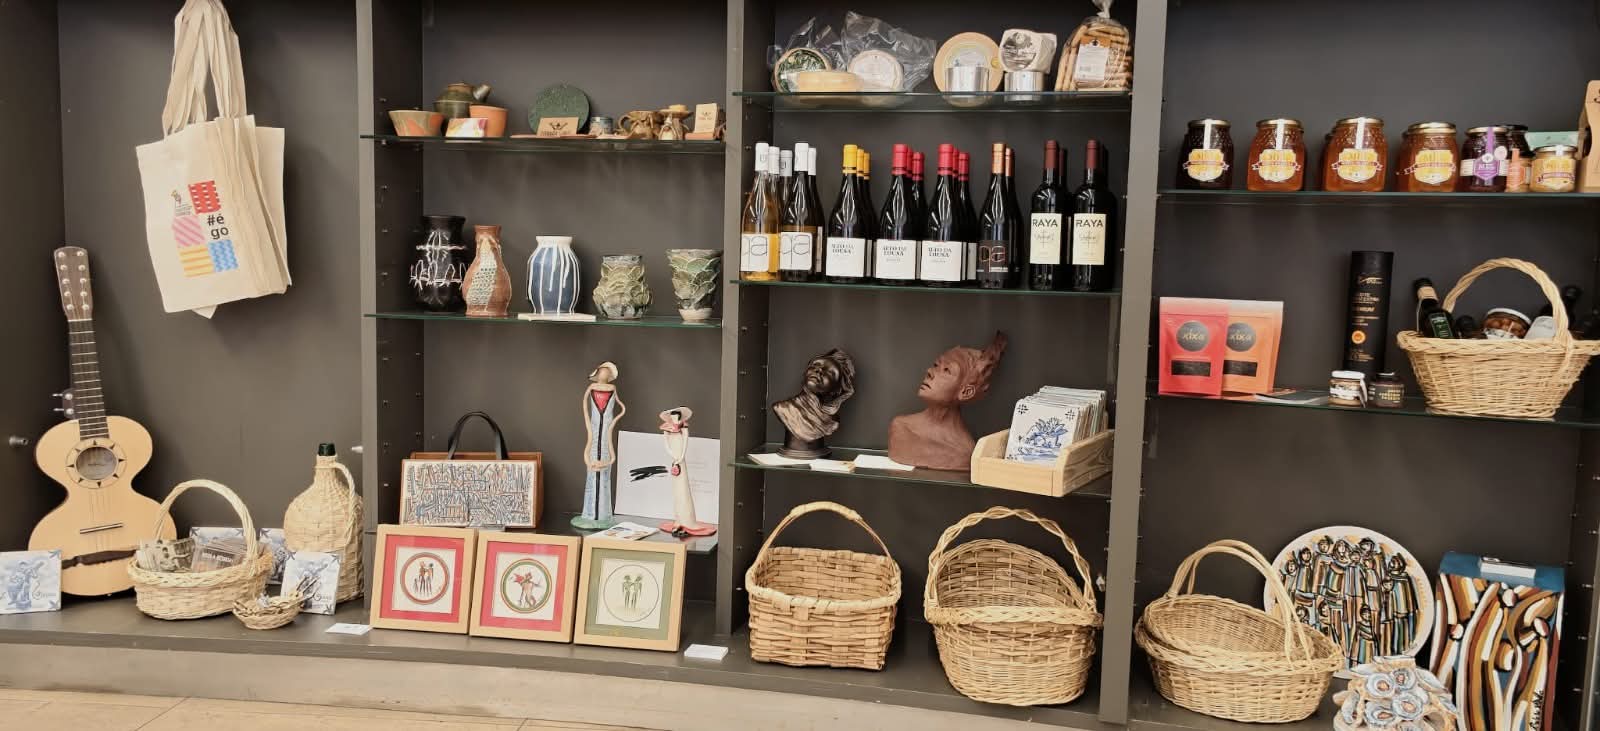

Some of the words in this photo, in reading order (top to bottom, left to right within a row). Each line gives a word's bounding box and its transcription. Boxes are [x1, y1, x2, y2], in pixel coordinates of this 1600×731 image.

[207, 213, 224, 226] #é
[1032, 219, 1058, 227] RAYA
[211, 227, 229, 239] go
